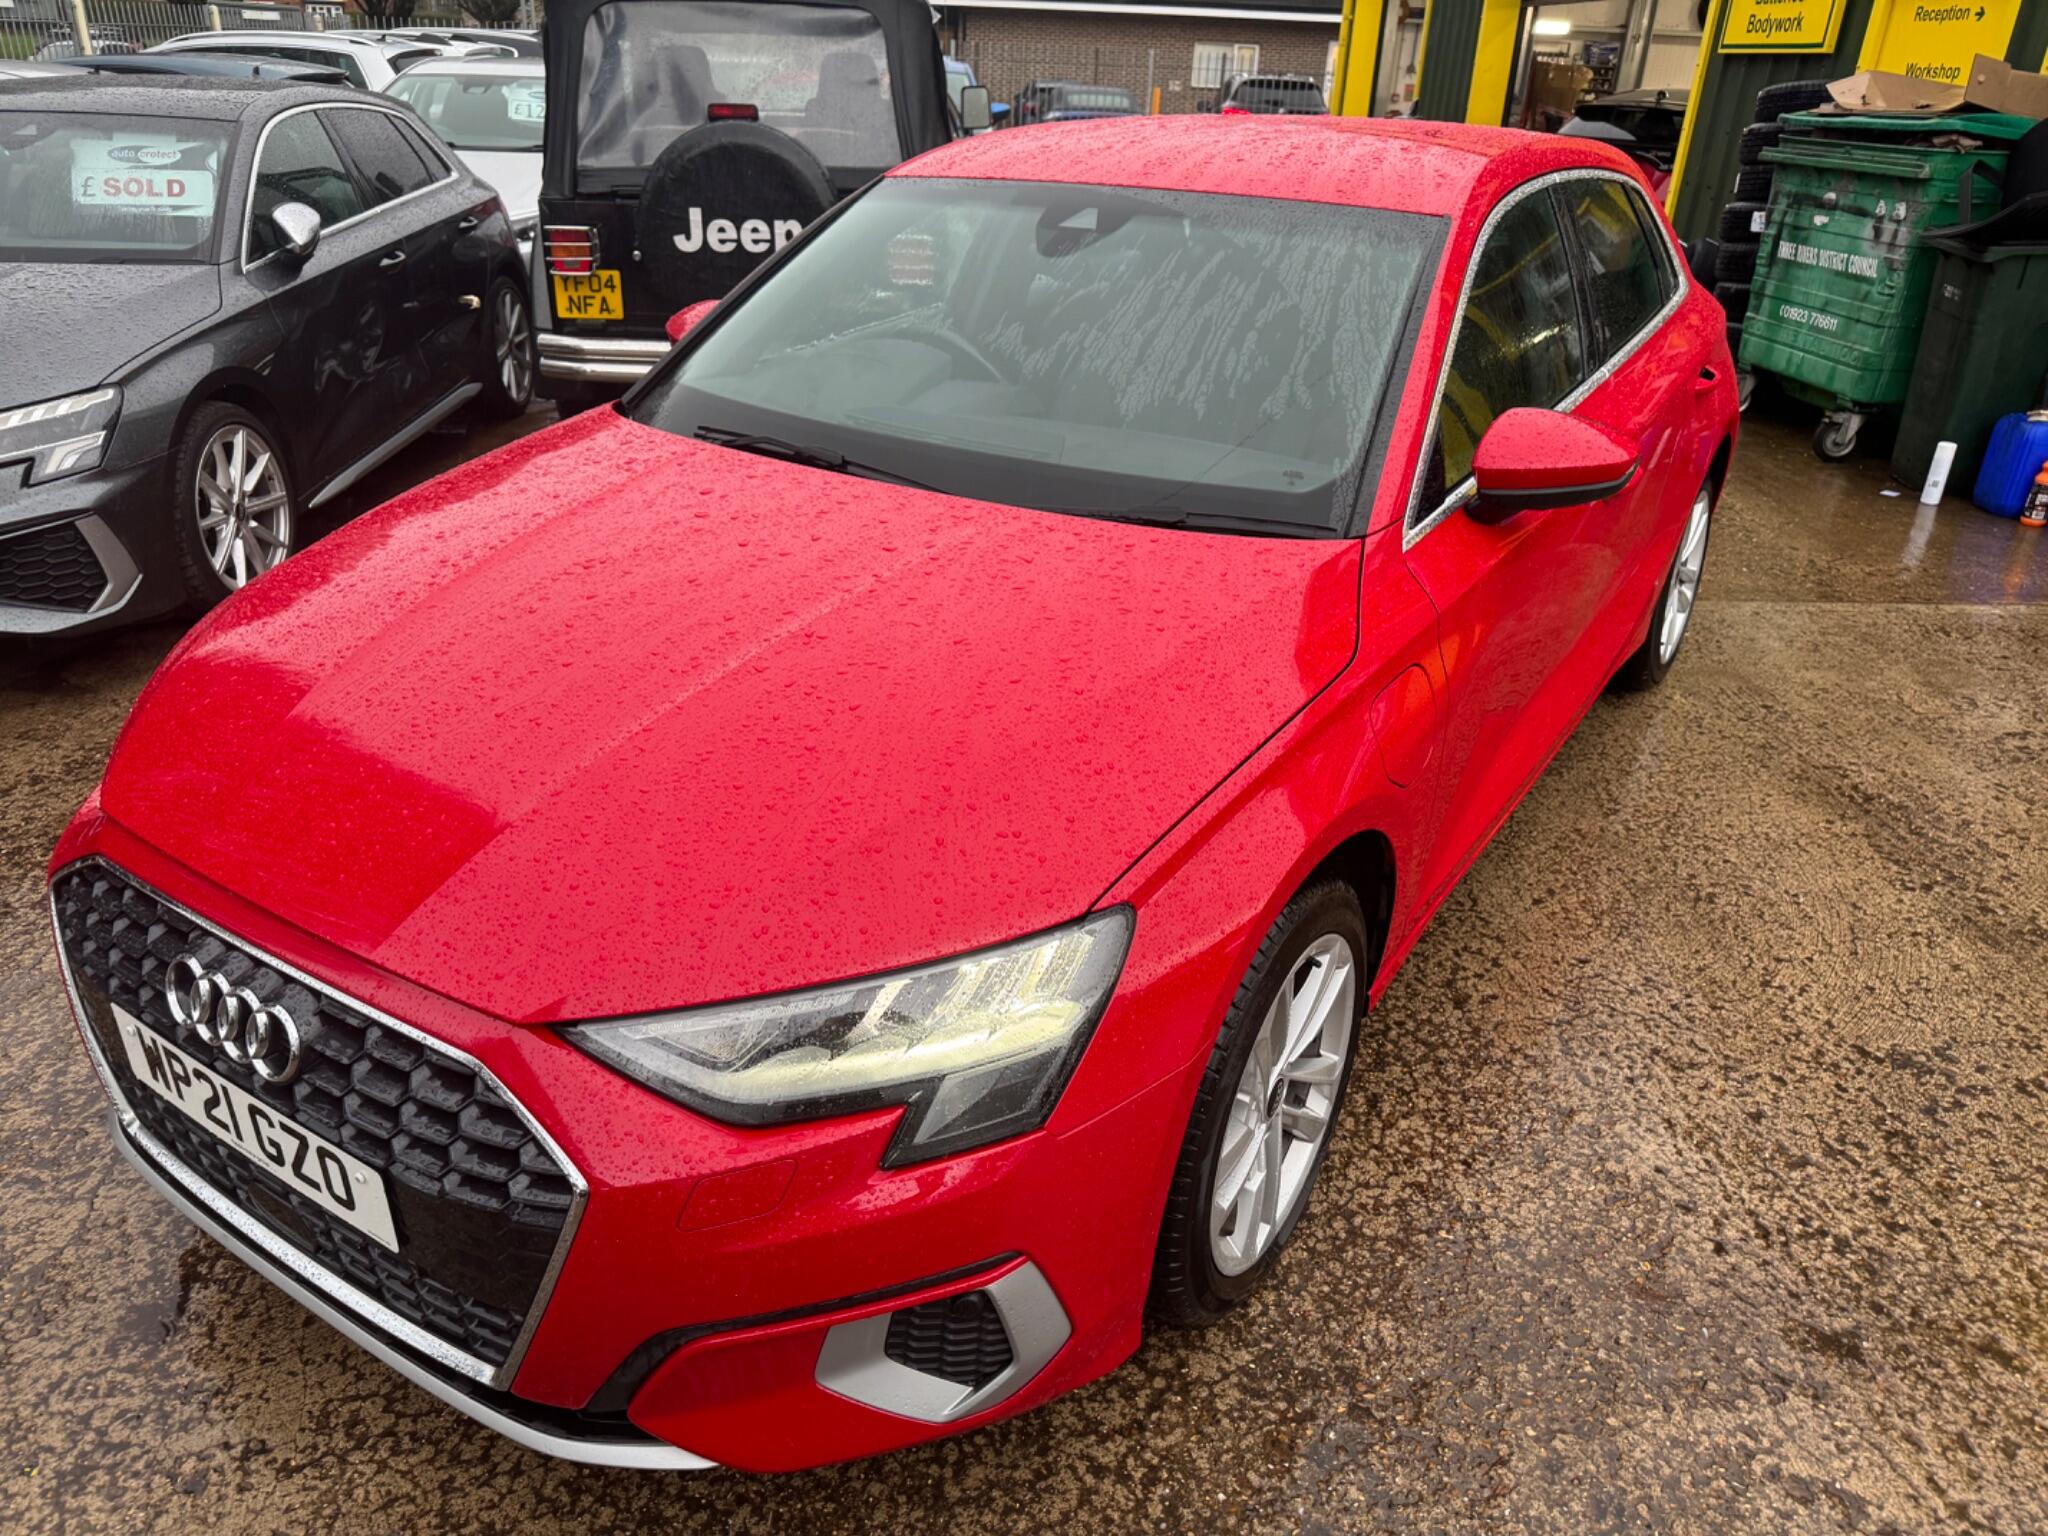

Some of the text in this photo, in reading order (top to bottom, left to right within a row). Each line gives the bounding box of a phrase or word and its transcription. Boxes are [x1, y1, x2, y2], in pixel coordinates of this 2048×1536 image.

[1746, 11, 1804, 38] Bodywork
[1914, 5, 1970, 24] Reception
[1905, 62, 1960, 81] Workshop
[112, 150, 135, 158] auto
[81, 176, 186, 197] £ SOLD
[673, 207, 804, 253] Jeep
[1778, 240, 1796, 260] THREE
[1819, 249, 1848, 271] DISTRICT
[559, 273, 617, 293] YF04
[568, 296, 612, 315] NFA
[135, 1024, 355, 1211] WP21 GZO
